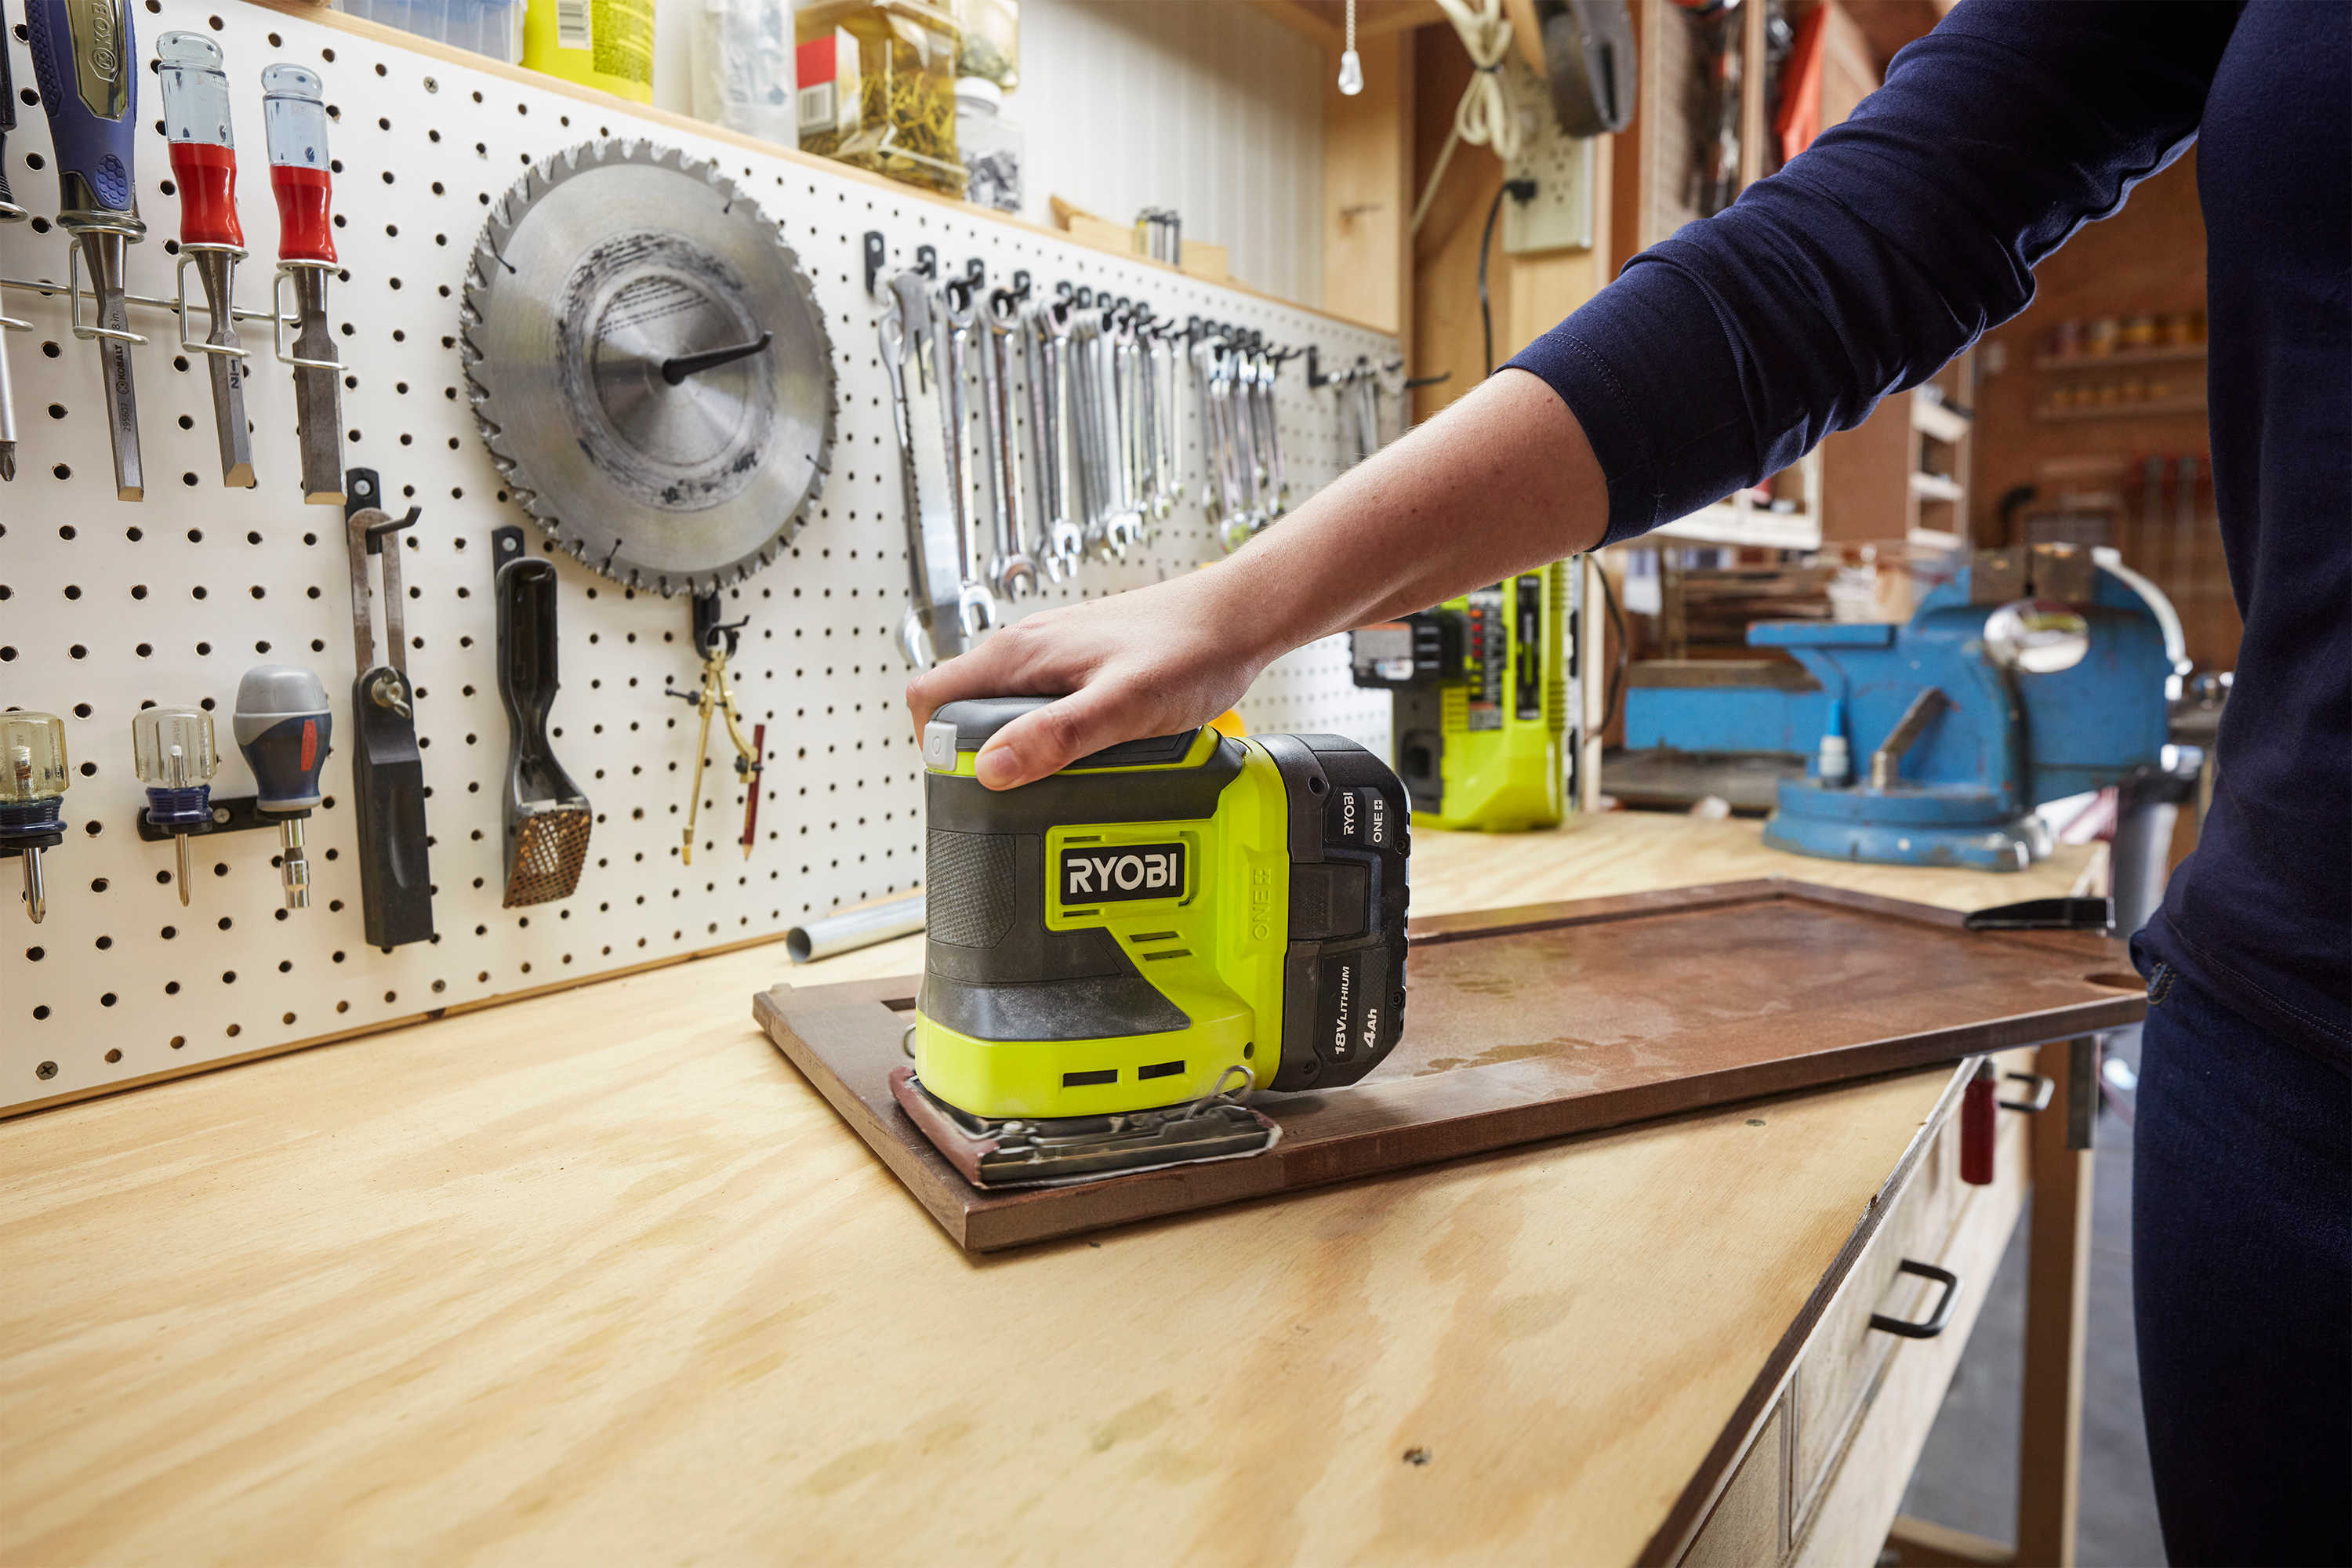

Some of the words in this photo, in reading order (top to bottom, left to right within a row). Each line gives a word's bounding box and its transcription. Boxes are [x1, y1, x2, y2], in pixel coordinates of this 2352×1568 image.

[114, 344, 125, 380] KOBALT
[1343, 792, 1355, 836] RYOBI
[1066, 853, 1177, 894] RYOBI
[1364, 1008, 1377, 1048] 4Ah
